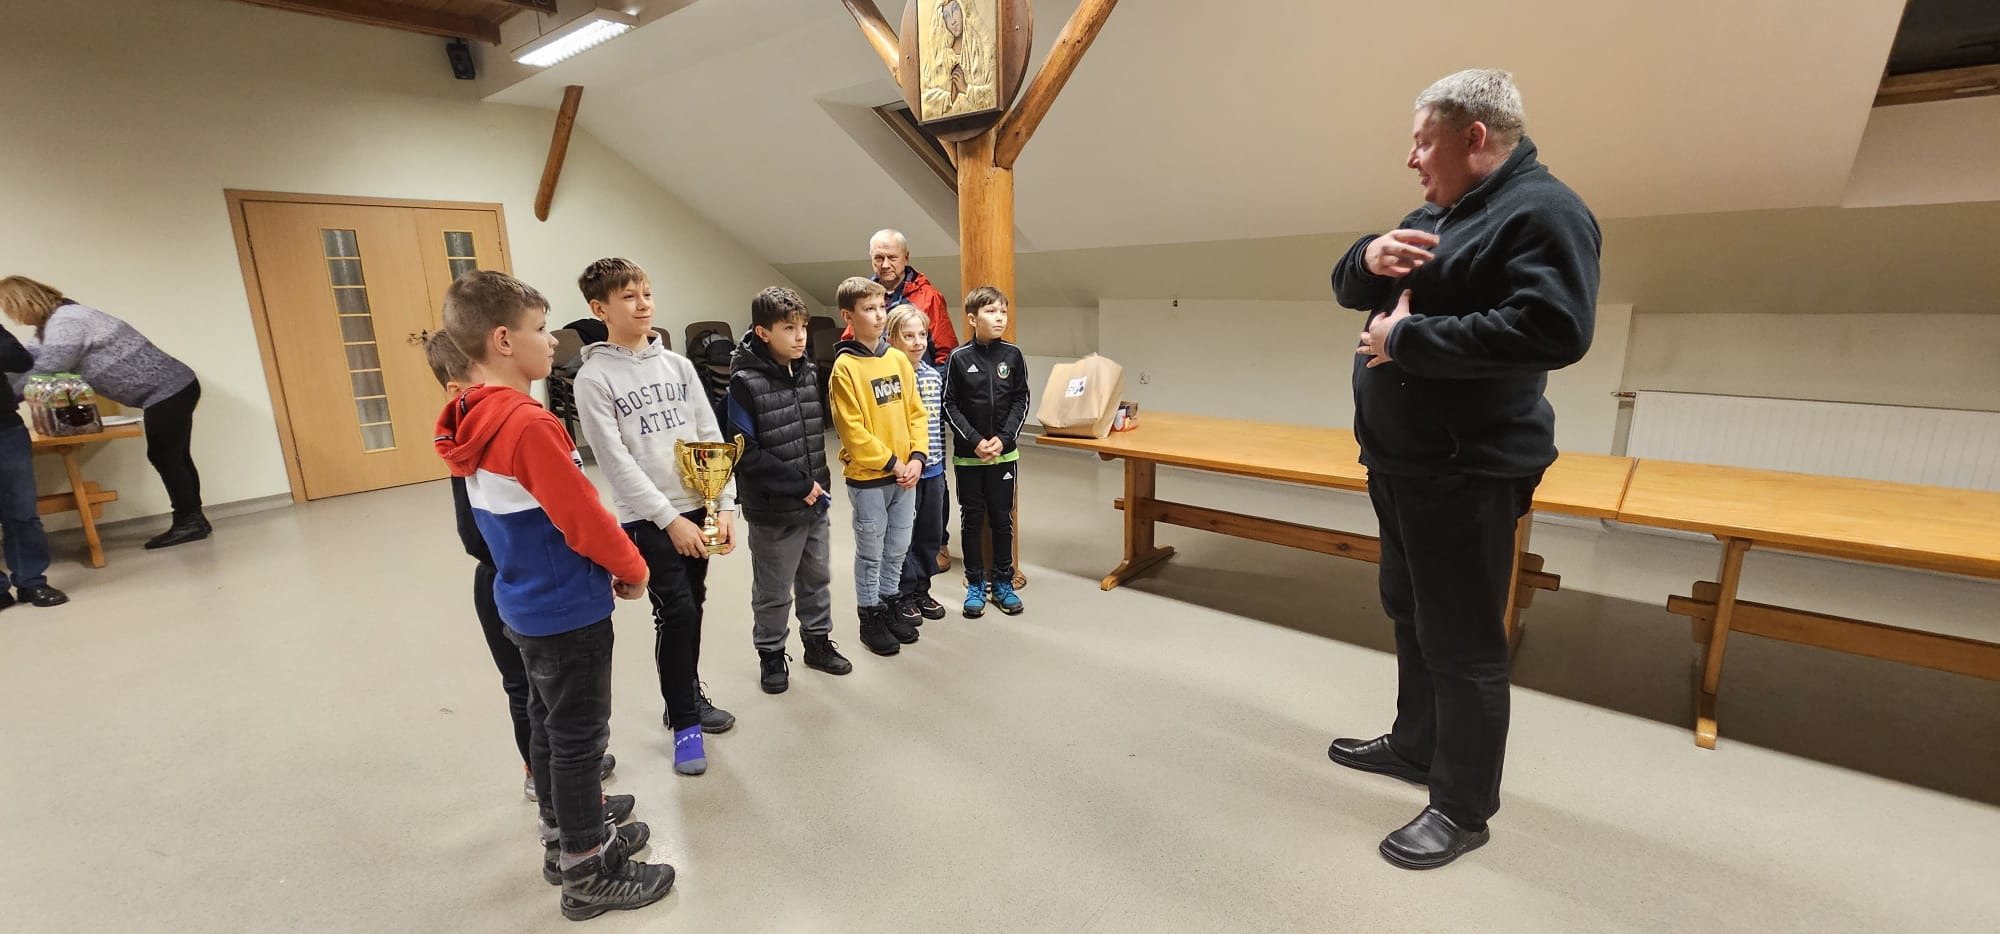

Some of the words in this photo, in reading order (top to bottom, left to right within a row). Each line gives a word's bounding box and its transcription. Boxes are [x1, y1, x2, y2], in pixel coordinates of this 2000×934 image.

[614, 383, 688, 417] BOSTON
[874, 382, 901, 398] MOVE
[640, 407, 685, 435] ATHL
